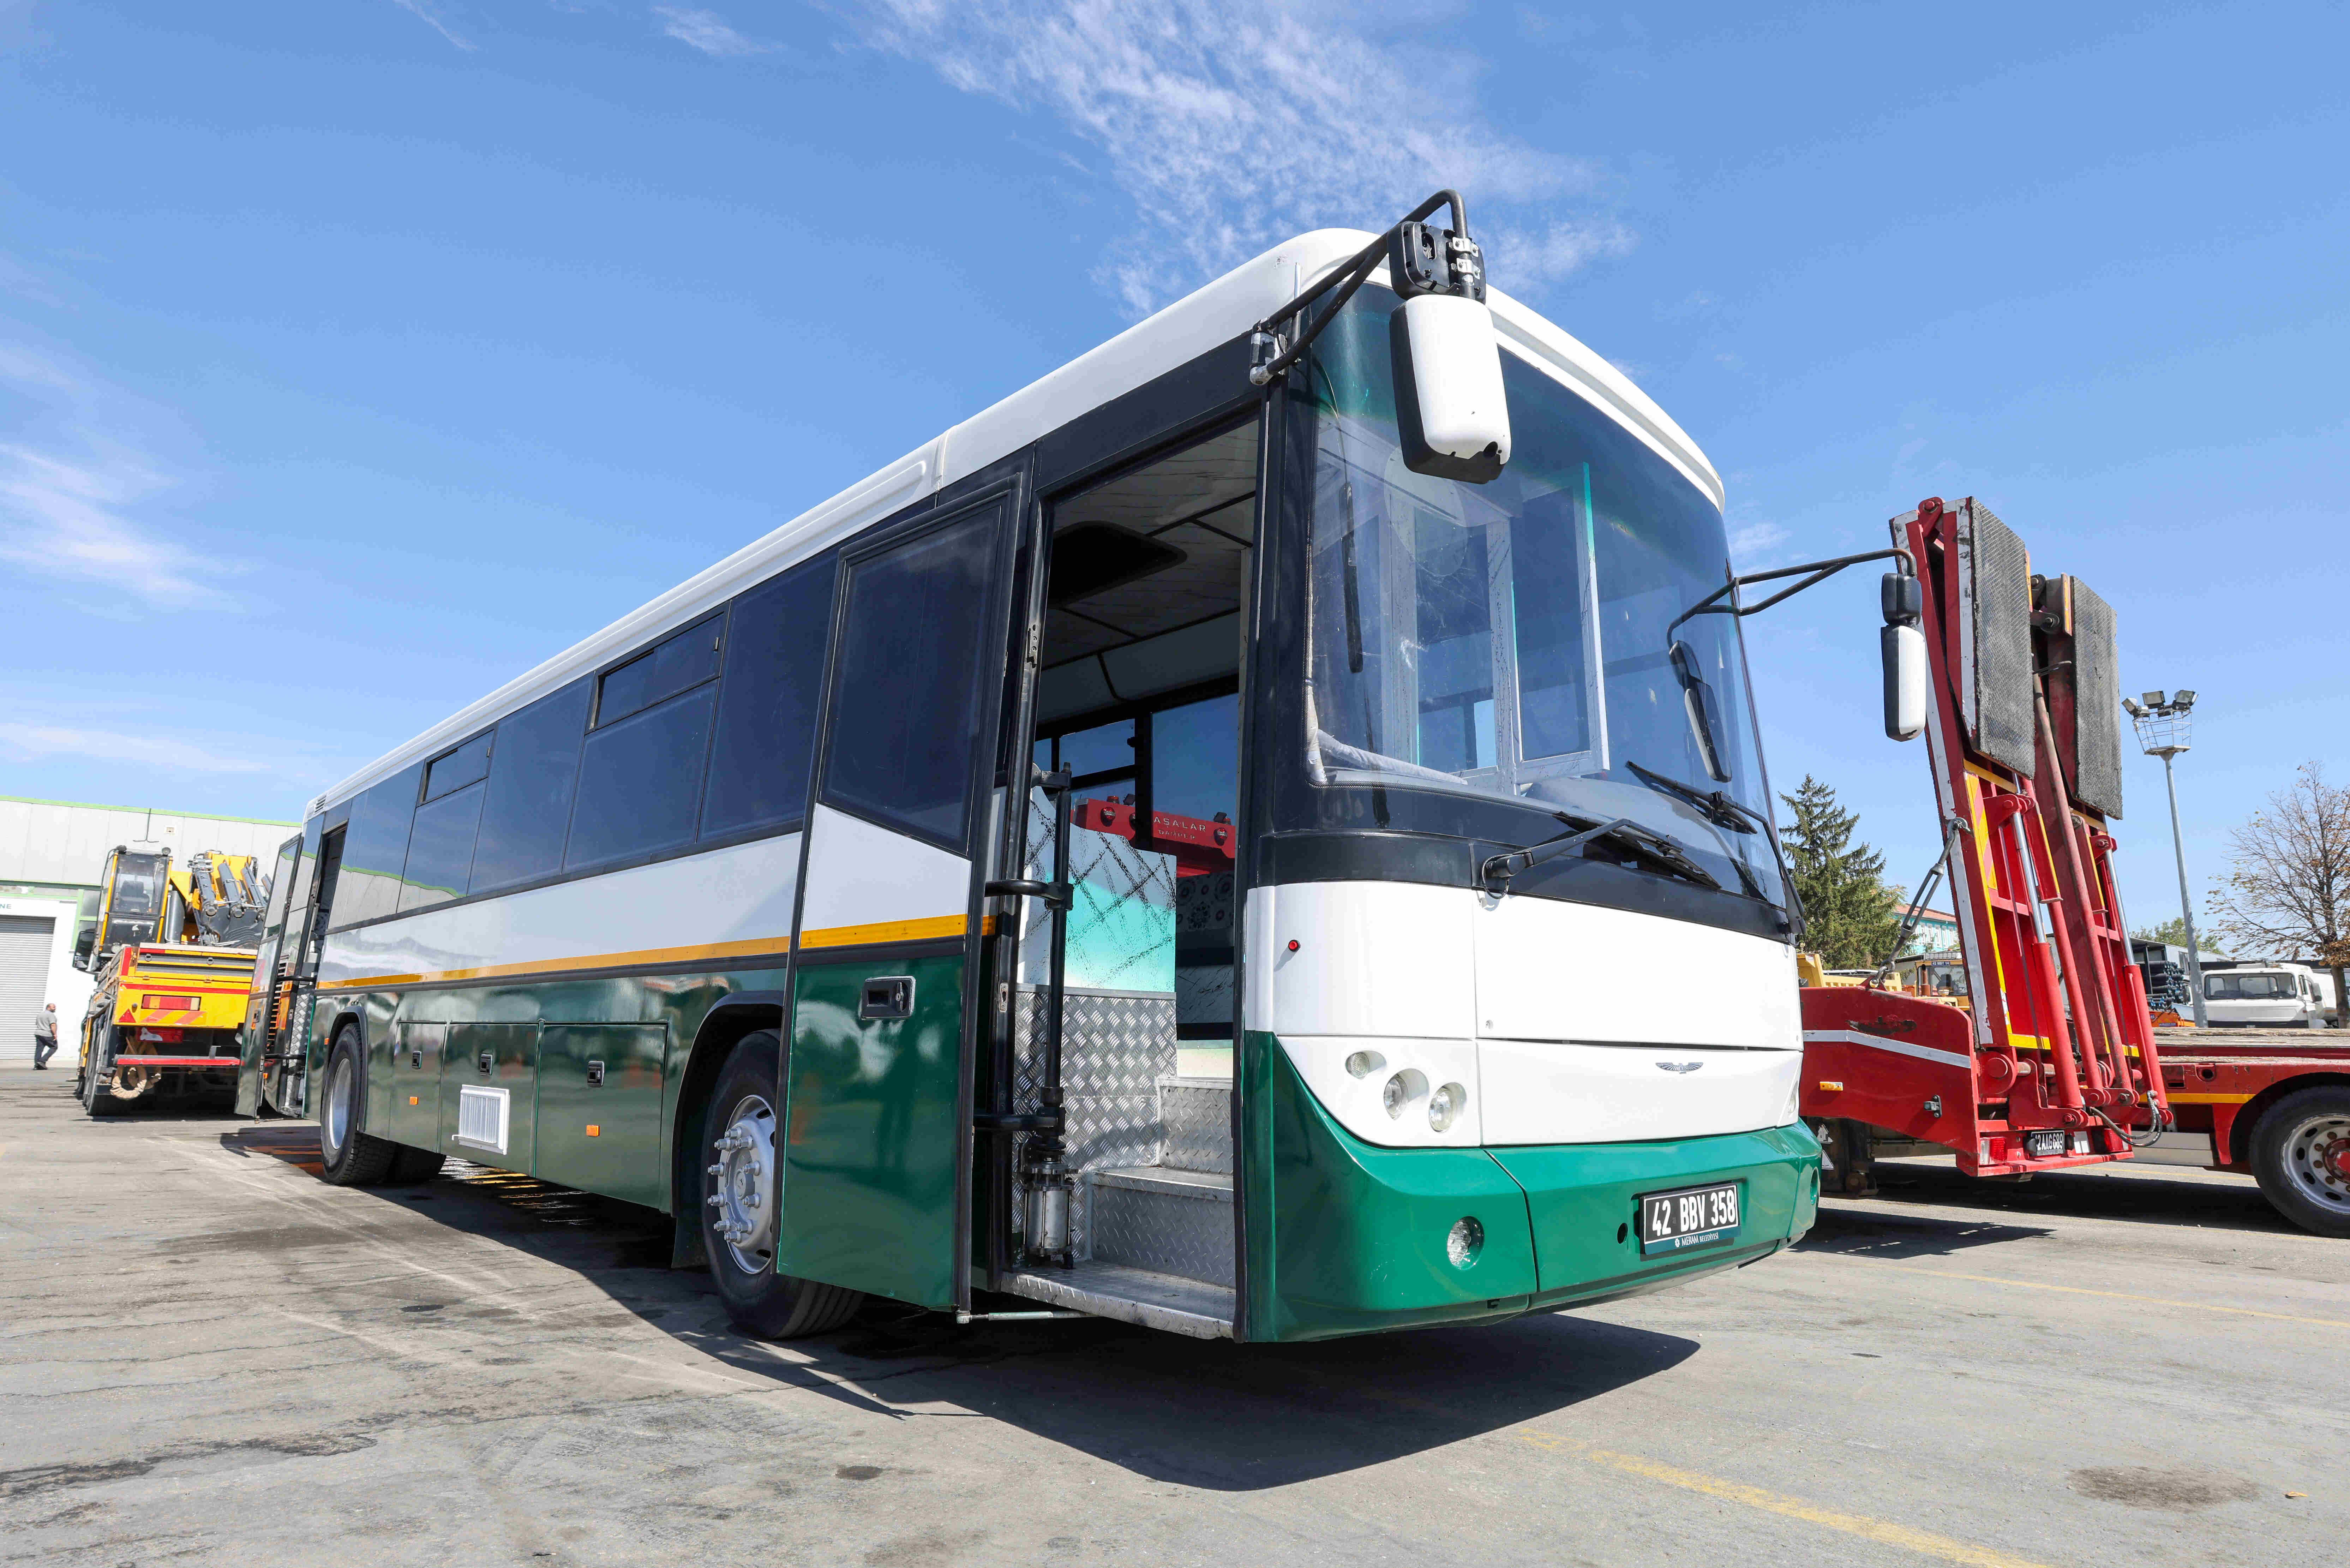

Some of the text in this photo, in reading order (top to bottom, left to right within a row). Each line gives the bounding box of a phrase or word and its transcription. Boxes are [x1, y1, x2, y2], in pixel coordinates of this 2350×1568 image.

[1652, 1190, 1736, 1236] 42 BBV 358
[1681, 1231, 1719, 1246] MERAM BELEDİYESİ
